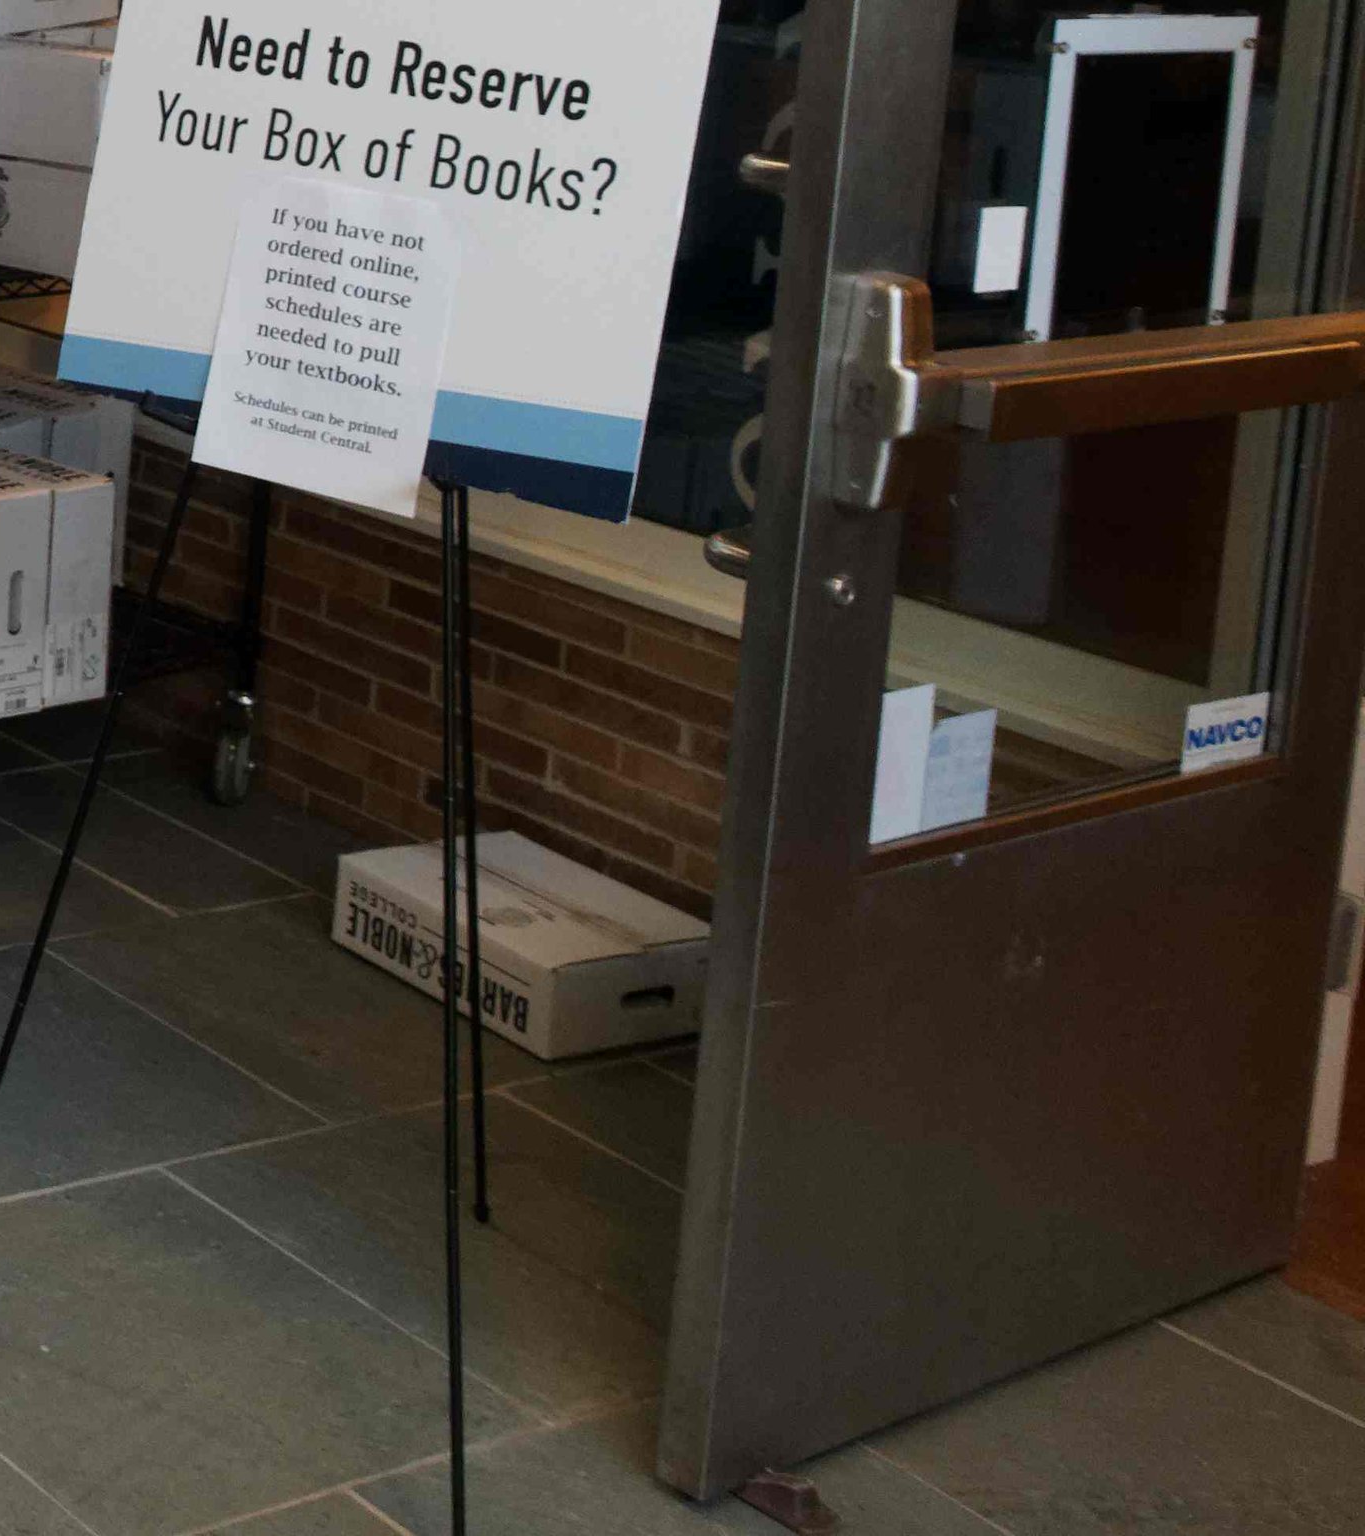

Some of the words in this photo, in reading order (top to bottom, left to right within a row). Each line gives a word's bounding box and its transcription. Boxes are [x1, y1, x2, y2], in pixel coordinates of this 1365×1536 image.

[195, 15, 311, 81] Need
[327, 36, 370, 90] to
[389, 40, 591, 121] Reserve
[157, 90, 249, 154] Your
[263, 107, 347, 172] Box
[364, 128, 415, 183] of
[429, 132, 618, 216] Books?
[271, 208, 289, 226] If
[293, 214, 328, 233] you
[335, 218, 384, 244] have
[390, 231, 425, 251] not
[267, 238, 344, 266] ordered
[349, 254, 420, 282] online,
[265, 266, 337, 294] printed
[342, 282, 412, 309] course
[265, 295, 363, 329] schedules
[368, 317, 402, 337] are
[256, 323, 327, 350] needed
[332, 337, 353, 356] to
[359, 345, 402, 366] pull
[244, 348, 291, 371] your
[297, 359, 402, 397] textbooks.
[233, 390, 299, 417] Schedules
[301, 407, 325, 423] can
[328, 412, 345, 427] be
[347, 418, 399, 441] printed
[250, 414, 264, 427] at
[266, 418, 317, 441] Student
[1187, 715, 1263, 749] NAVCO
[349, 881, 418, 929] COLLEGE
[346, 902, 413, 969] NOBLE
